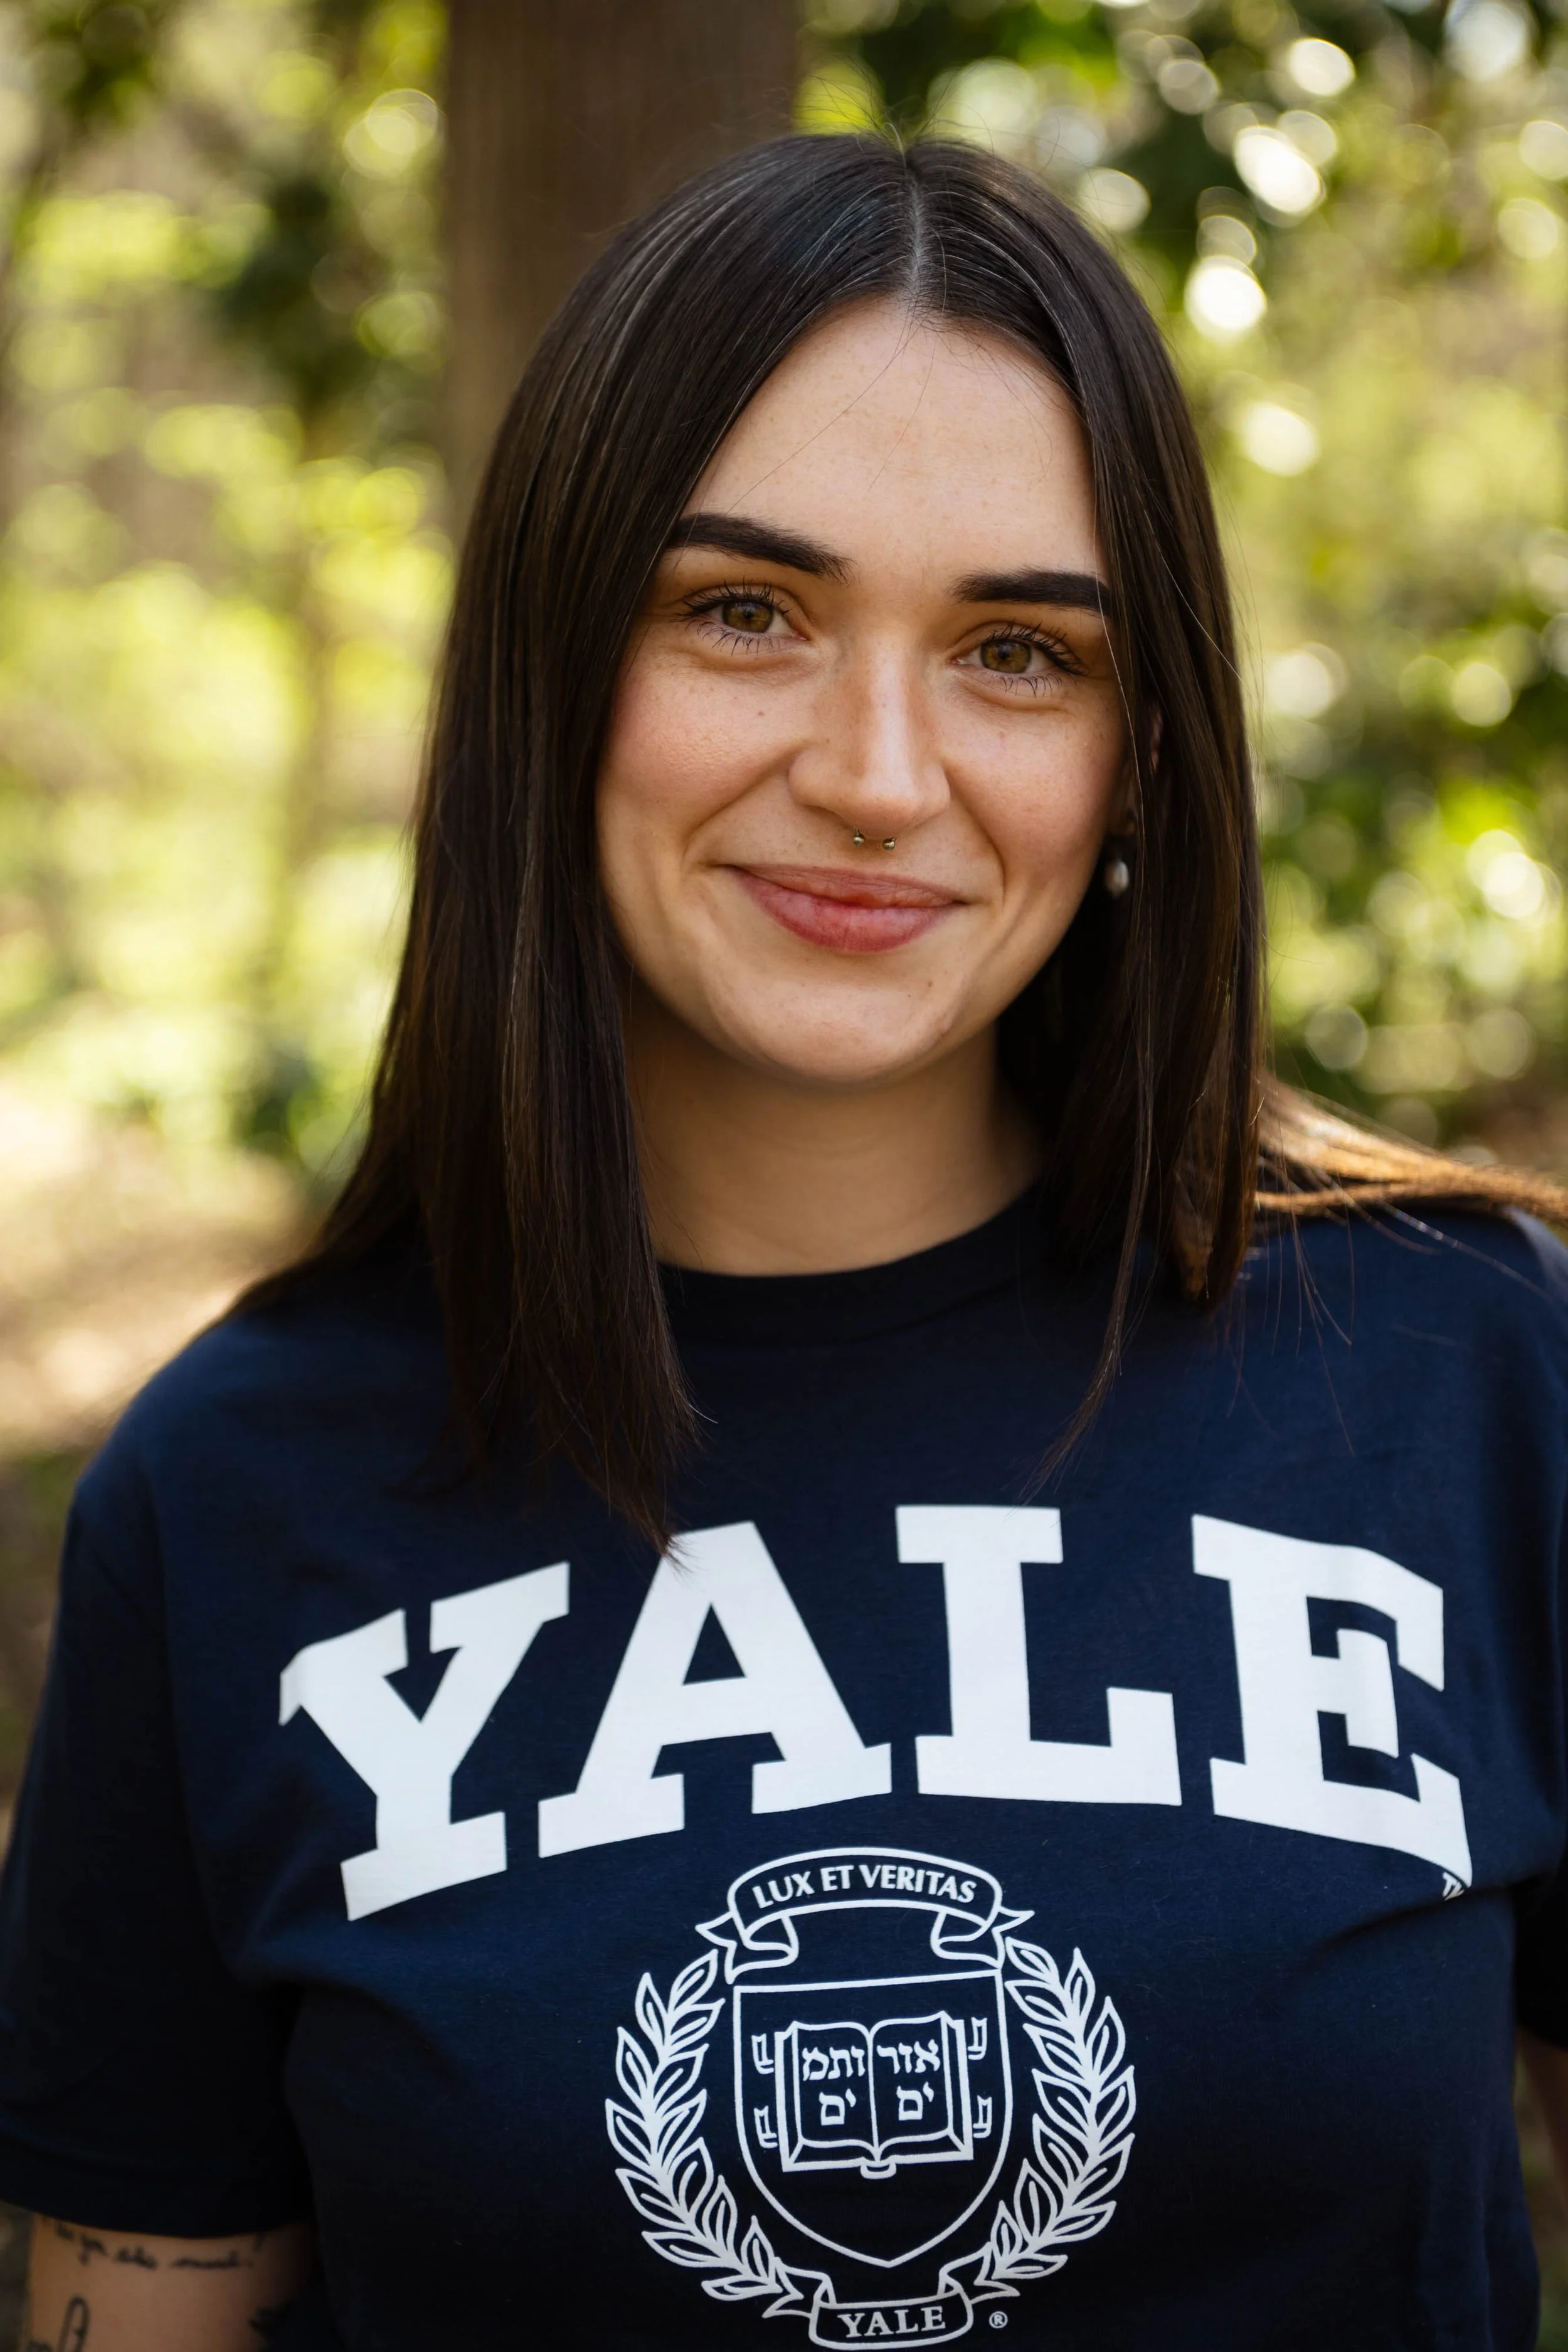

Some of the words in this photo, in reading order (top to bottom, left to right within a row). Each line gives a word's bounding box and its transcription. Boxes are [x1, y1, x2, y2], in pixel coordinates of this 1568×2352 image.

[280, 1505, 1472, 1920] YALE
[752, 1871, 815, 1909] LUX
[820, 1865, 854, 1892] ET
[859, 1864, 977, 1903] VERITAS
[802, 2045, 867, 2082] ותמ
[876, 2038, 941, 2074] אור
[818, 2088, 857, 2126] ים
[896, 2081, 935, 2121] ים
[837, 2306, 946, 2338] YALE
